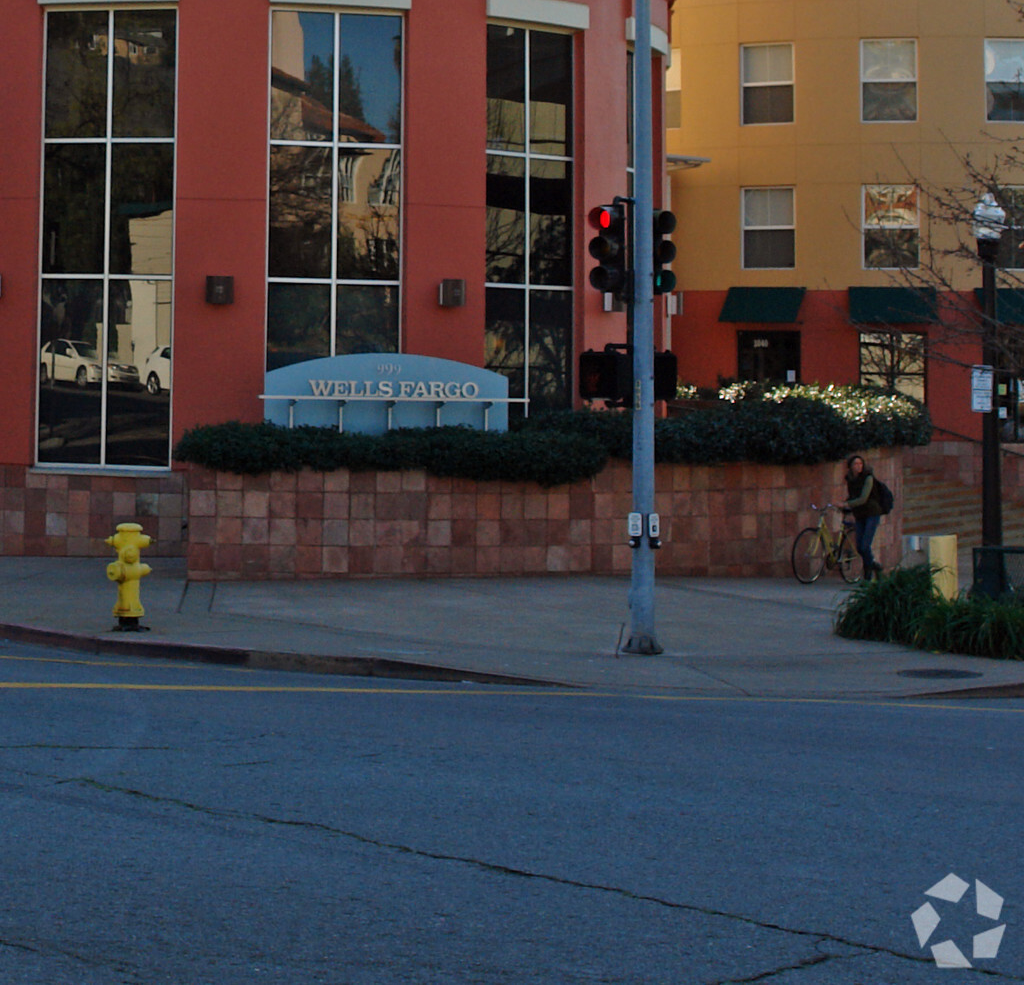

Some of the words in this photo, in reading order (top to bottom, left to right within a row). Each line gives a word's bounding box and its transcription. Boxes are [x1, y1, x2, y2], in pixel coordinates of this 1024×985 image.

[377, 363, 402, 376] 999
[309, 380, 393, 397] WELLS
[399, 381, 479, 399] FARGO
